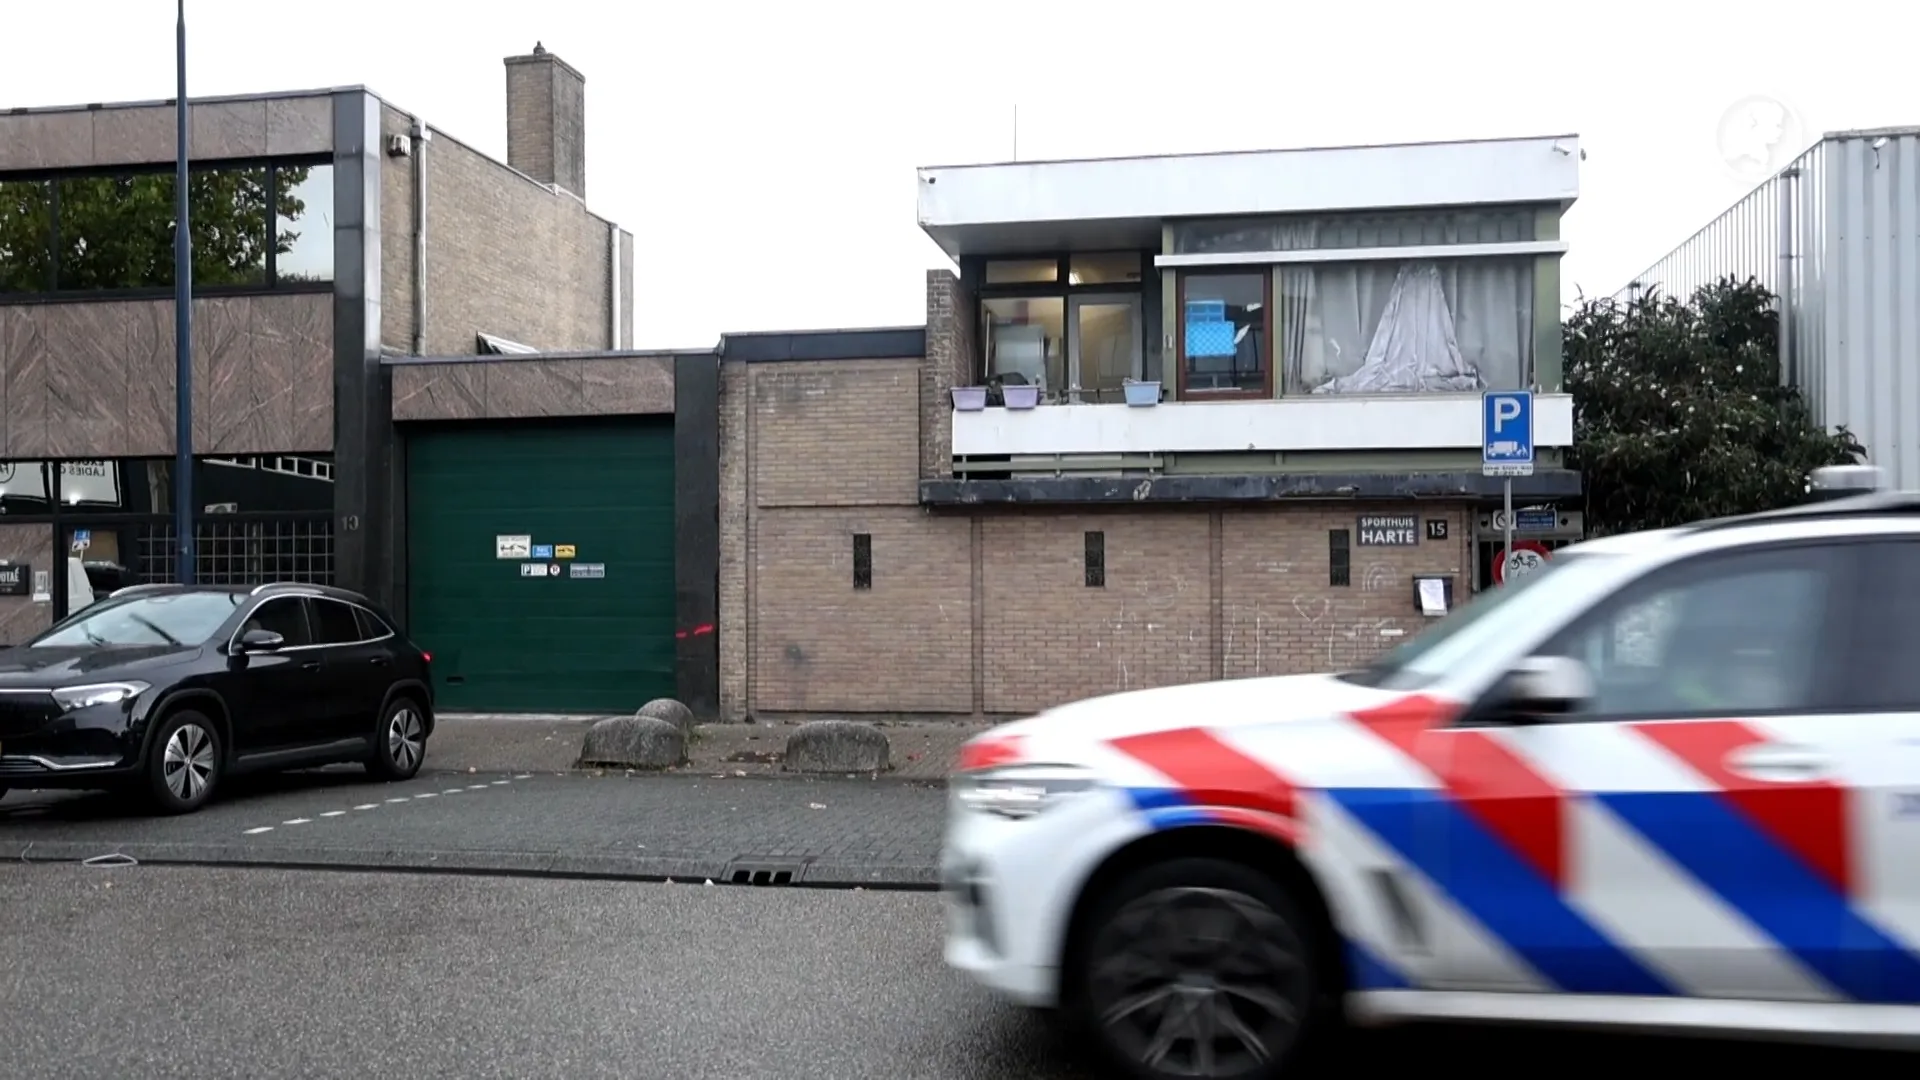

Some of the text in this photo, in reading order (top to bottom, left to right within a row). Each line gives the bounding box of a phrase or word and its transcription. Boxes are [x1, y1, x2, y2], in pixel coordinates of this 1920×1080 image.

[1494, 397, 1521, 433] P
[1361, 517, 1414, 527] SPORTHUIS
[1429, 522, 1446, 536] 15
[1361, 529, 1415, 544] HARTE
